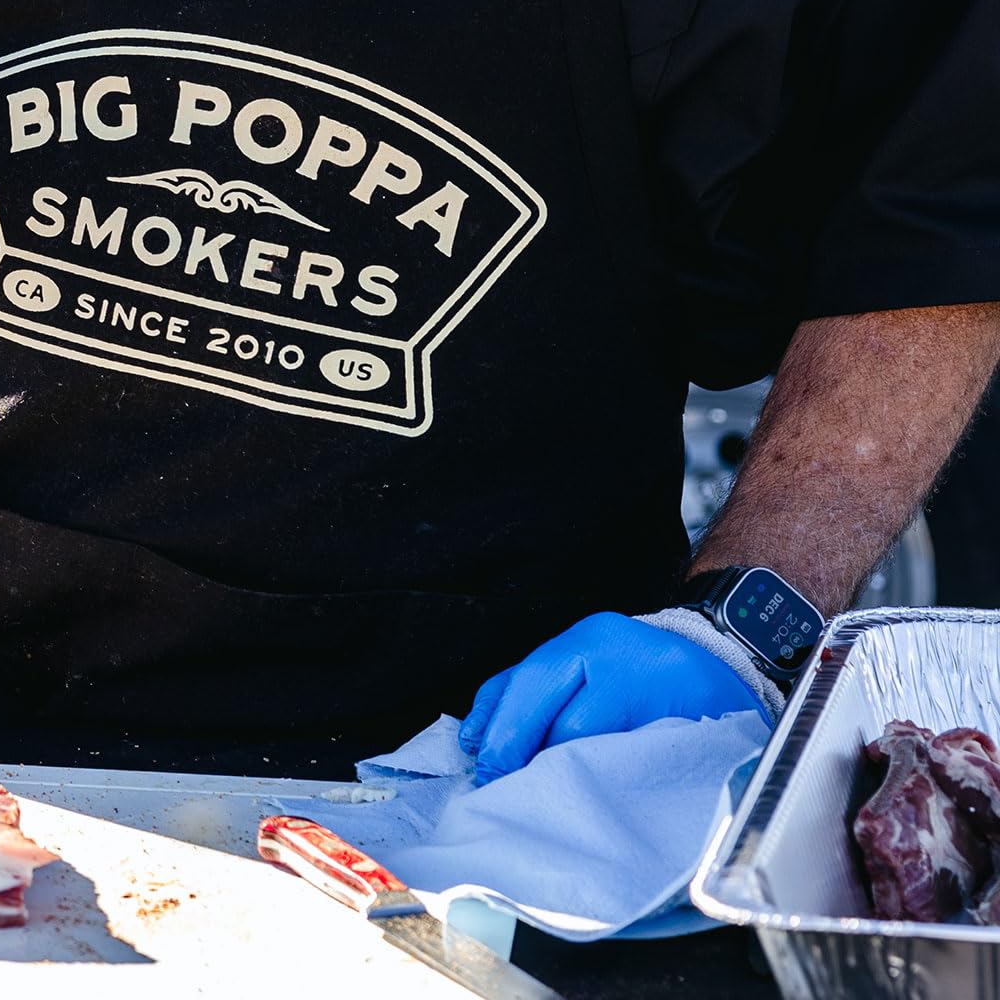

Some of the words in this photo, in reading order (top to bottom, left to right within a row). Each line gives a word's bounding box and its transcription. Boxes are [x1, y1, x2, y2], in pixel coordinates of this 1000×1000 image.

[7, 76, 137, 153] BIG
[169, 81, 469, 257] POPPA
[26, 187, 399, 316] SMOKERS
[14, 278, 45, 303] CA
[75, 293, 190, 343] SINCE
[206, 328, 304, 369] 2010
[338, 358, 373, 381] US
[760, 612, 769, 622] 6
[765, 592, 785, 615] DEC
[772, 612, 798, 644] 2:04
